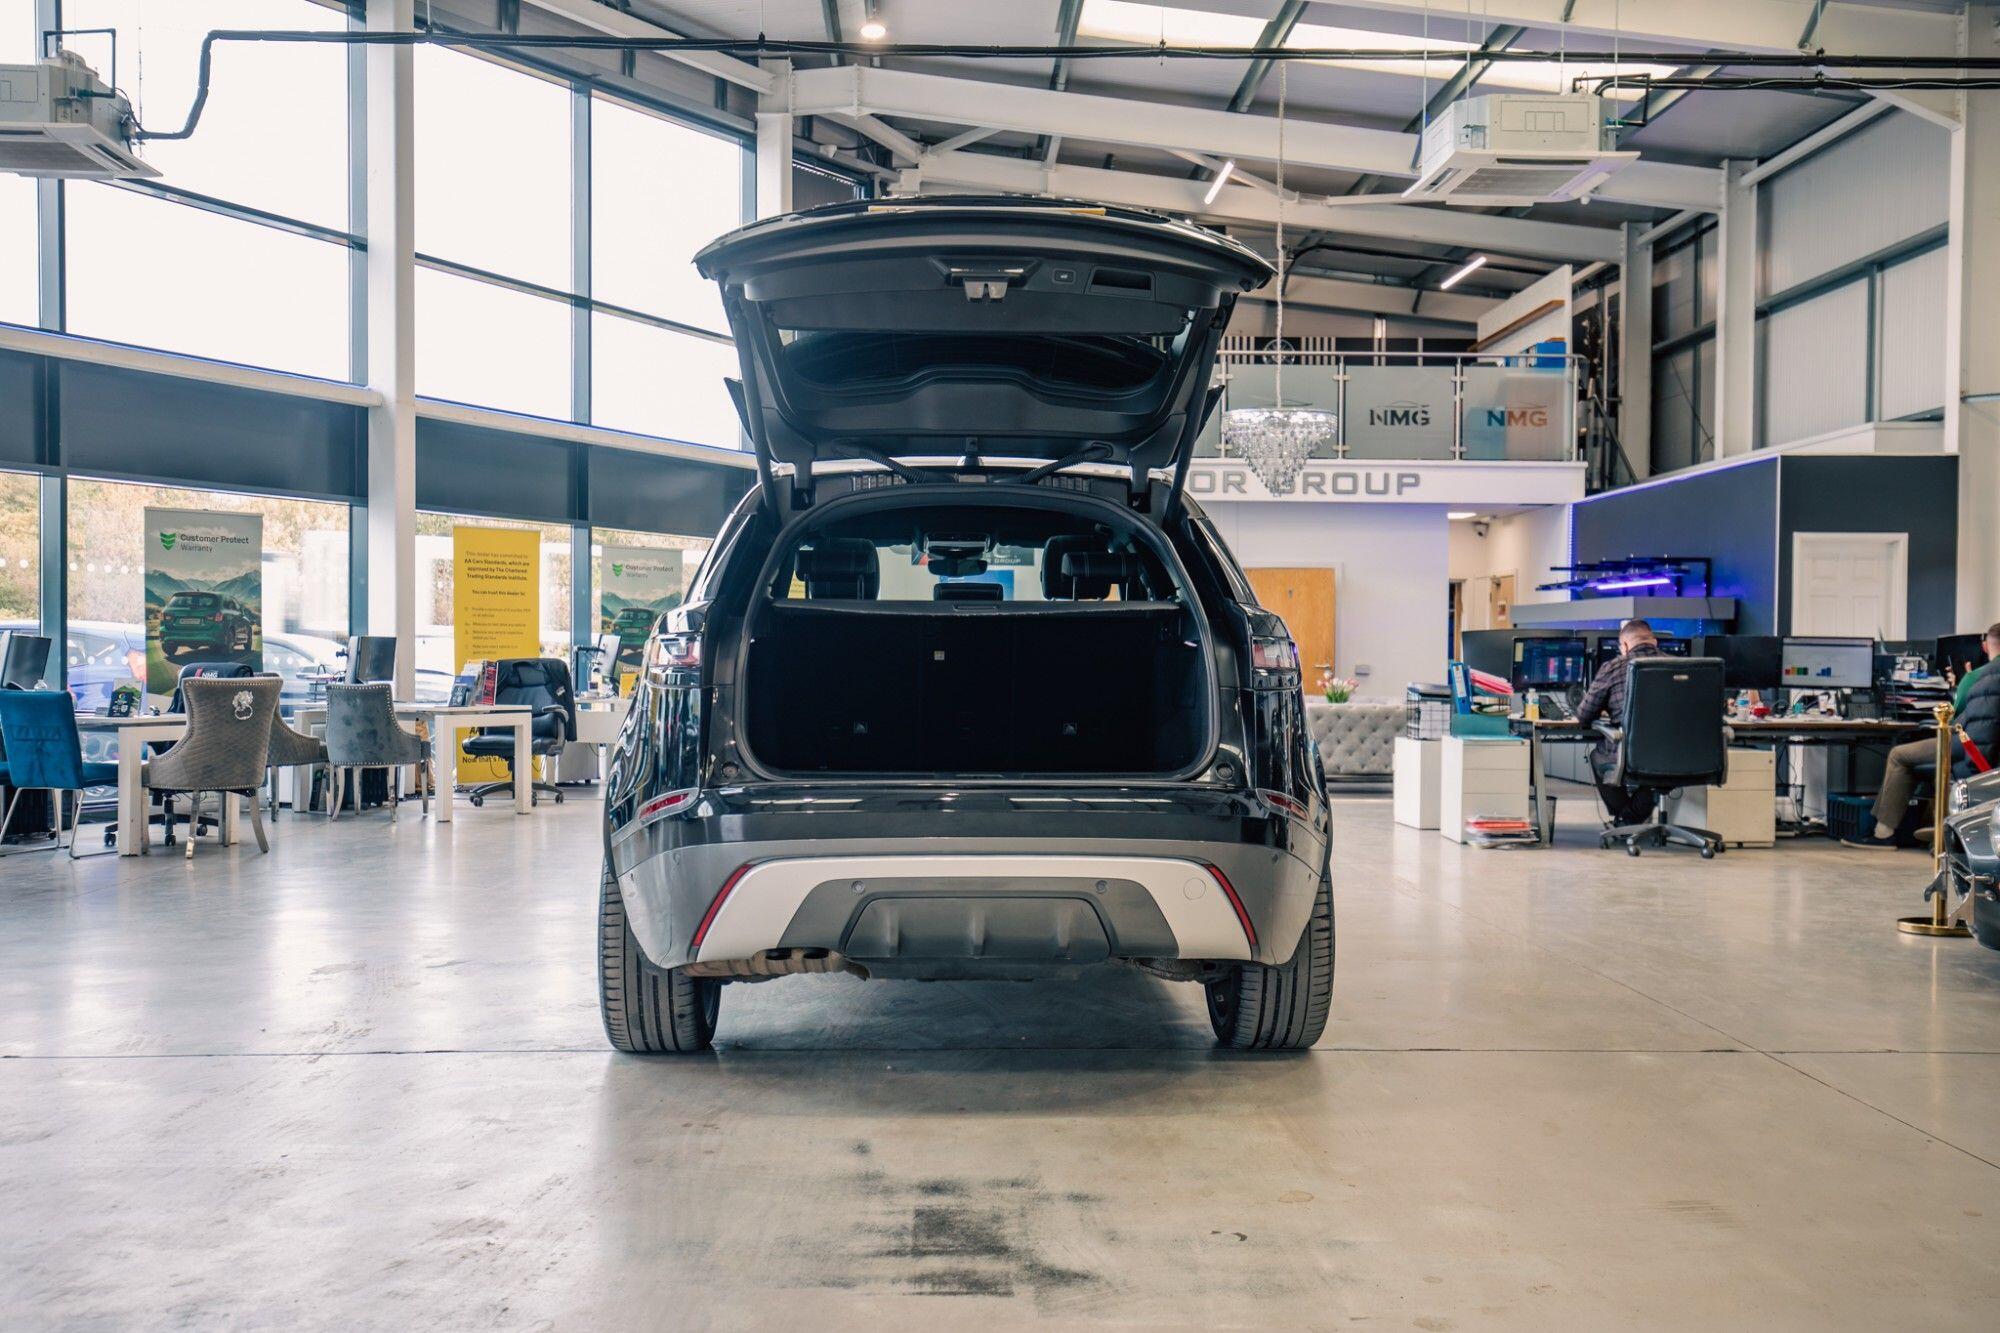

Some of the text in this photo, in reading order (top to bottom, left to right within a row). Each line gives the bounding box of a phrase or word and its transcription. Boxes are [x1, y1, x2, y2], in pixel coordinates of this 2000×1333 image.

[1369, 408, 1431, 426] NMG
[1487, 410, 1548, 427] NMG
[180, 533, 249, 544] Customer Protect
[180, 544, 213, 553] Warranty
